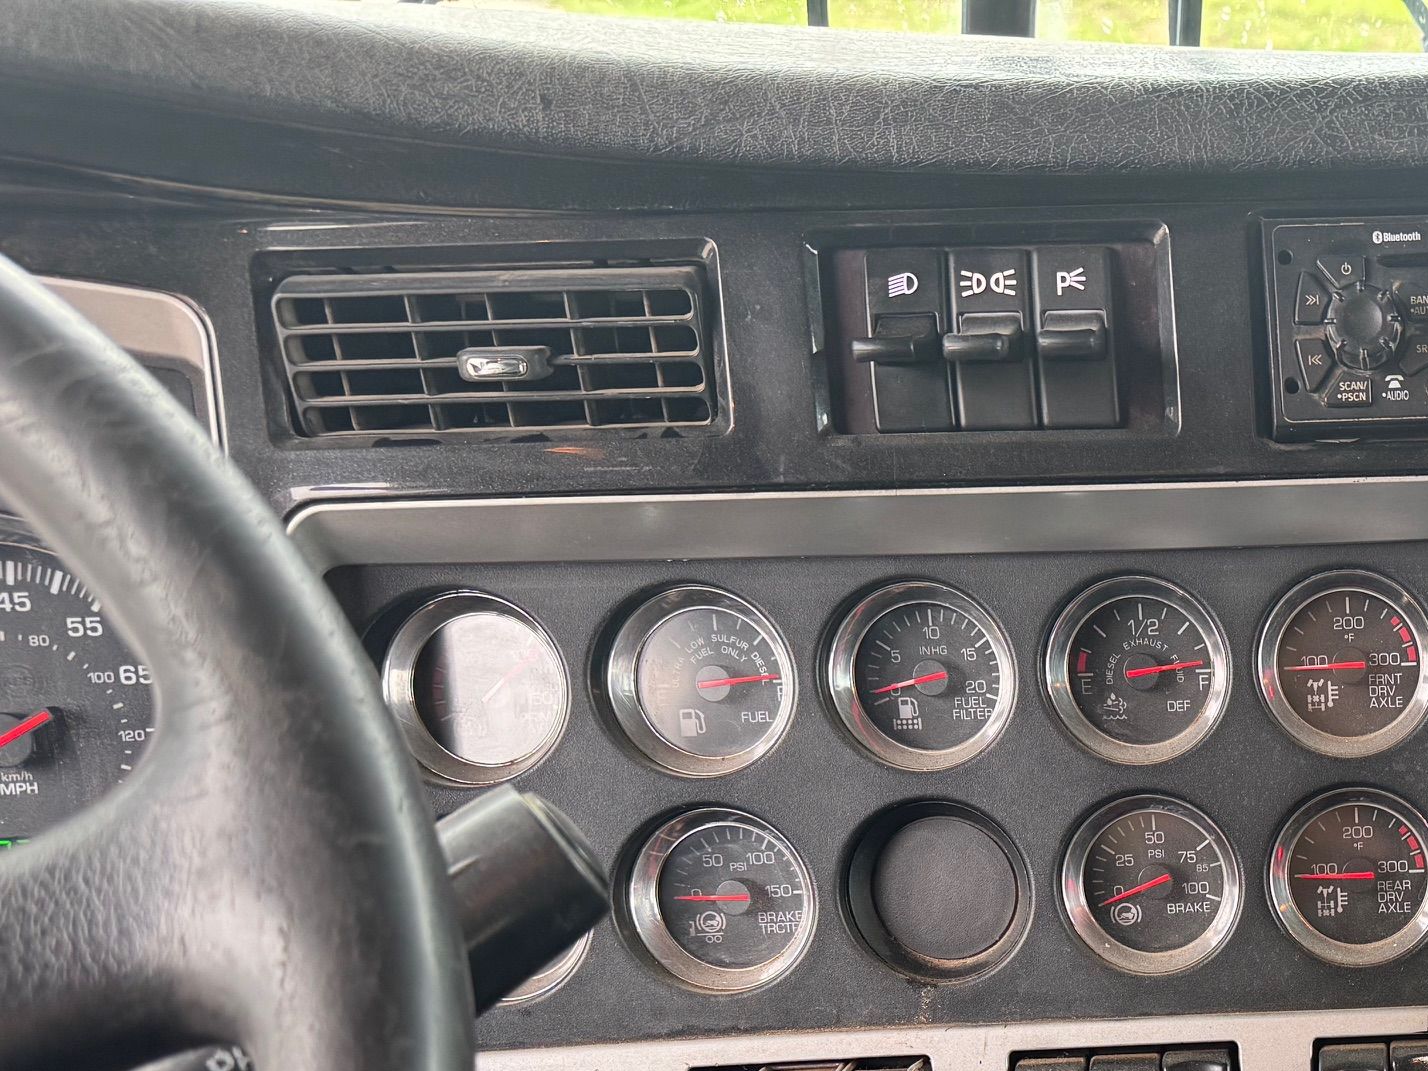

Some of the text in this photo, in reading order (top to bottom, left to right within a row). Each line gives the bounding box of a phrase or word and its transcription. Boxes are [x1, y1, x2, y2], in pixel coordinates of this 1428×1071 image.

[1383, 231, 1421, 242] Bluetooth
[1339, 381, 1367, 390] SCAN/
[0, 592, 31, 611] 45
[66, 617, 103, 637] 55
[1127, 619, 1159, 637] 1/2
[1333, 616, 1365, 630] 200
[923, 626, 940, 639] 10
[28, 634, 50, 647] 80
[685, 636, 705, 654] LOW
[711, 634, 750, 651] SULFUR
[691, 646, 748, 665] FUEL ONLY
[891, 650, 901, 663] 5
[960, 648, 977, 661] 15
[1300, 655, 1328, 667] 100
[1369, 653, 1400, 666] 300
[1106, 653, 1121, 685] DIESEL
[1123, 639, 1169, 651] EXHAUST
[87, 671, 115, 683] 100
[119, 665, 152, 685] 65
[1369, 673, 1403, 685] FRNT
[965, 680, 987, 693] 20
[1081, 678, 1092, 695] E
[1199, 674, 1209, 691] F
[1369, 686, 1396, 697] DRV
[954, 696, 987, 708] FUEL
[1167, 700, 1191, 712] DEF
[1370, 697, 1403, 708] AXLE
[741, 711, 773, 723] FUEL
[953, 708, 992, 720] FILTER
[118, 729, 145, 742] 120
[1, 771, 33, 782] km/h
[0, 782, 39, 795] MPH
[1145, 831, 1165, 844] 50
[1342, 825, 1373, 838] 200
[702, 851, 775, 872] 50 PSI 100
[1115, 849, 1196, 867] 25 PSI 75
[1196, 864, 1209, 872] 85
[1311, 863, 1338, 875] 100
[1377, 860, 1408, 873] 300
[765, 884, 792, 898] 150
[1182, 881, 1210, 895] 100
[1377, 880, 1411, 891] REAR
[1378, 891, 1404, 903] DRV
[1167, 901, 1211, 914] BRAKE
[1378, 902, 1411, 913] AXLE
[758, 910, 803, 923] BRAKE
